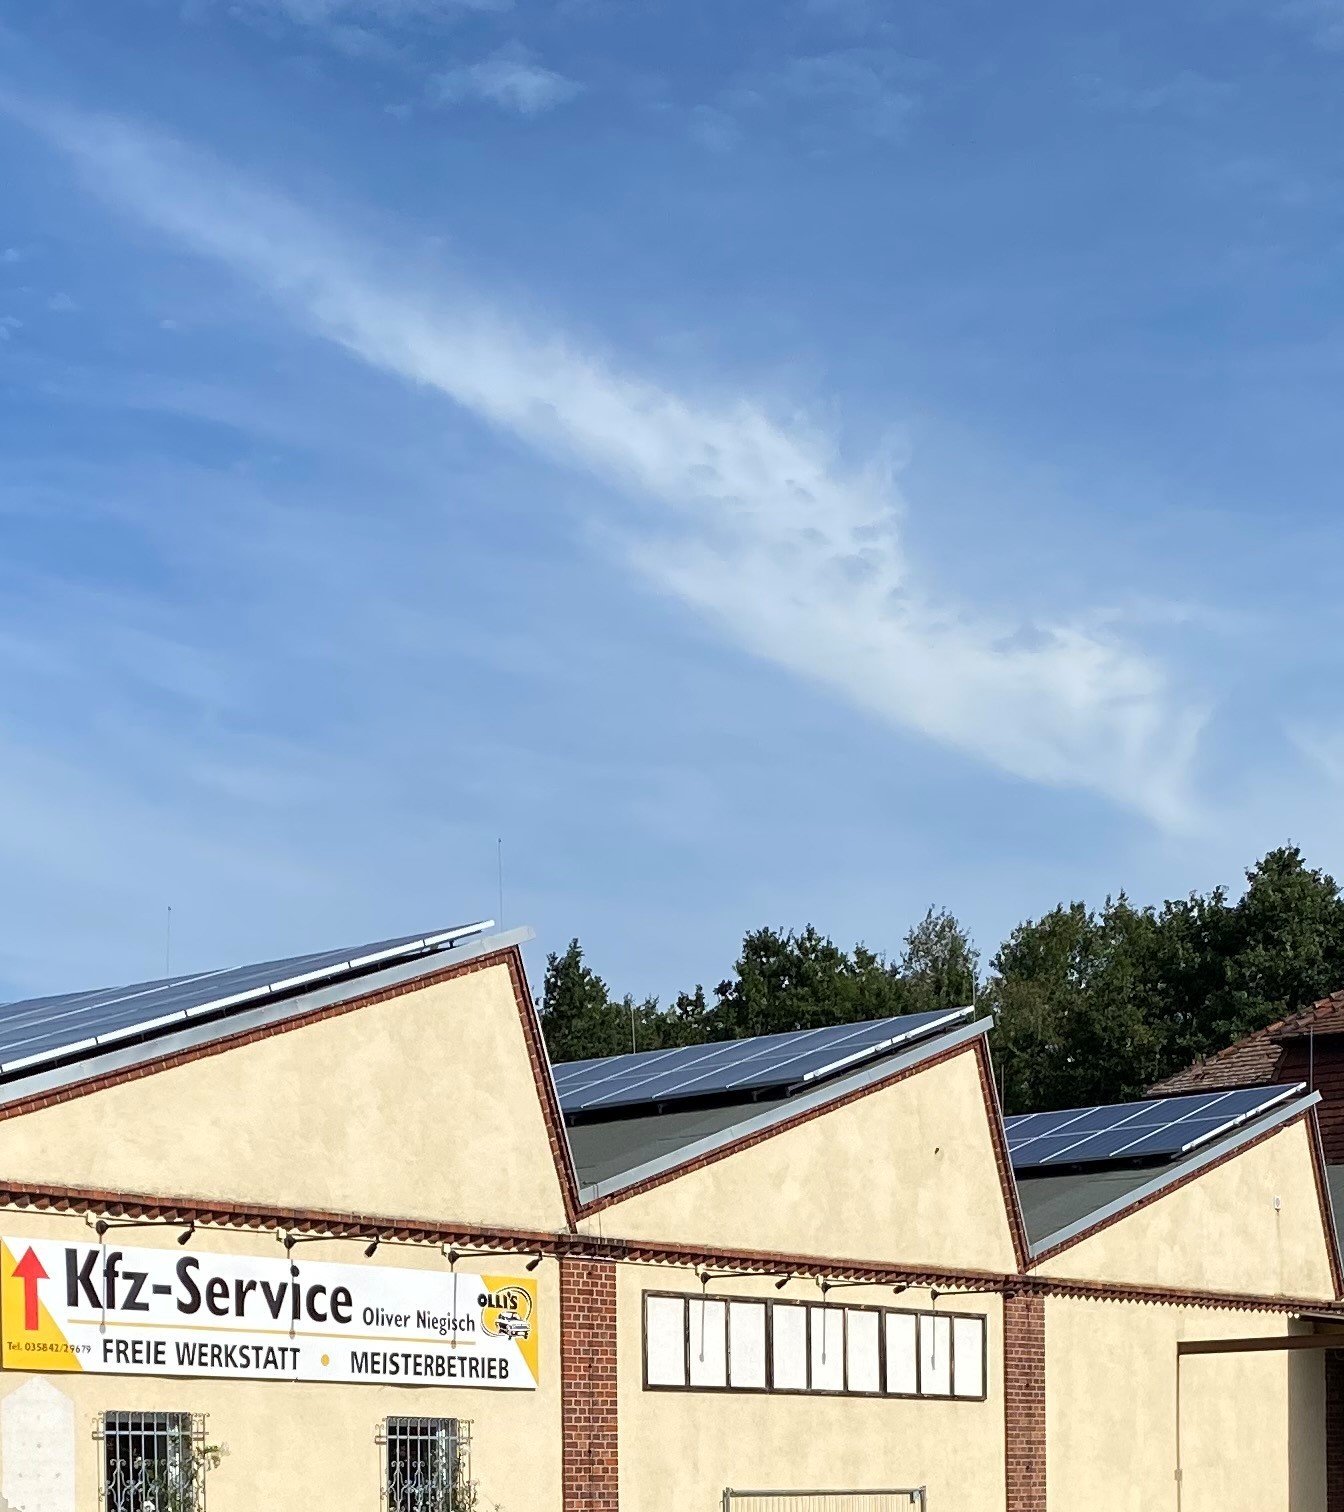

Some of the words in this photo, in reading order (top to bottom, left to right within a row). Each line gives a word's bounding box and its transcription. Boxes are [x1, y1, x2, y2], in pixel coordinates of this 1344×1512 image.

[65, 1248, 353, 1324] Kfz-Service
[477, 1291, 518, 1310] OLLI'S
[362, 1306, 411, 1328] Oliver
[416, 1310, 476, 1336] Niegisch
[24, 1342, 92, 1354] 035842/29679
[102, 1338, 167, 1365] FREIE
[175, 1341, 301, 1370] WERKSTATT
[350, 1351, 510, 1380] MEISTERBETRIEB
